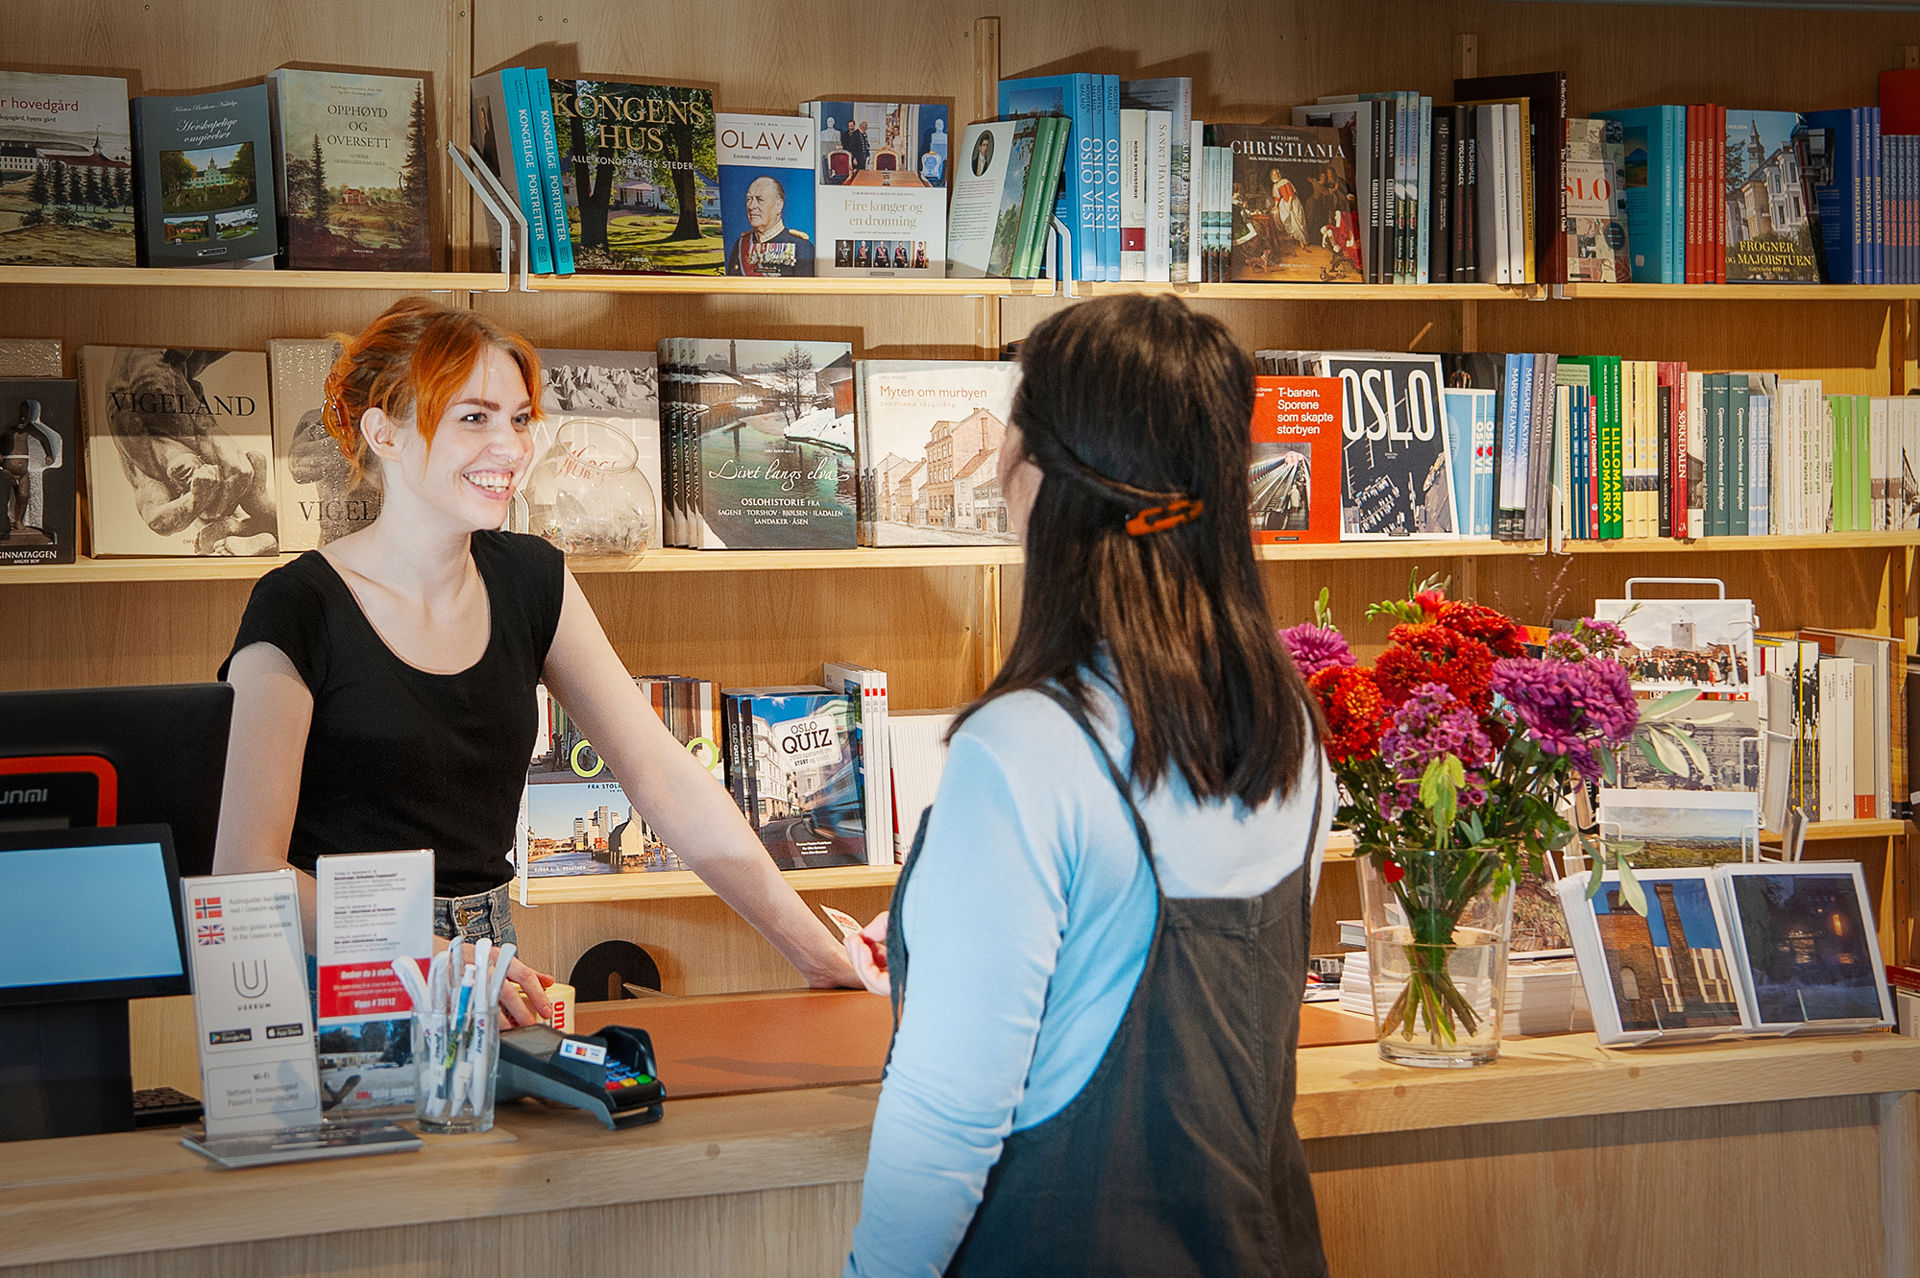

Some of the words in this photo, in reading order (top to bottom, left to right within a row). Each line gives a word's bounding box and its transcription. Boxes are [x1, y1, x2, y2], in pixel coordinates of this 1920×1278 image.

[11, 97, 79, 113] hovedgård
[327, 104, 388, 118] OPPHØYD
[553, 92, 706, 126] KONGENS
[348, 121, 368, 132] OG
[327, 135, 391, 148] OVERSETT
[599, 124, 664, 152] HUS
[1158, 124, 1167, 159] SANKT
[1181, 139, 1190, 159] SLIK
[1230, 140, 1345, 159] CHRISTIANIA
[571, 155, 590, 163] ALLE
[596, 157, 659, 168] KONGEPARETS
[662, 161, 694, 170] STEDER
[1081, 137, 1093, 184] OSLO
[1106, 139, 1119, 185] OSLO
[1181, 162, 1190, 179] BLE
[518, 109, 535, 168] KONGELIGE
[527, 174, 545, 240] PORTRETTER
[541, 110, 557, 169] KONGELIGE
[549, 175, 566, 242] PORTRETTER
[1385, 179, 1394, 209] CHRISTIAN
[1439, 184, 1449, 196] by
[844, 199, 868, 211] Fire
[870, 200, 908, 214] konger
[909, 203, 923, 214] og
[1081, 190, 1094, 232] VEST
[1106, 190, 1119, 233] VEST
[849, 216, 863, 226] en
[865, 215, 917, 229] dronning
[1386, 219, 1394, 227] BY
[1739, 240, 1795, 253] FROGNER
[1737, 253, 1812, 266] MAJORSTUEN
[880, 385, 914, 400] Myten
[917, 389, 935, 397] om
[939, 387, 987, 400] murbyen
[1277, 387, 1320, 397] T-banen.
[1536, 373, 1545, 415] KONGENS
[1546, 372, 1556, 415] KONGENS
[110, 391, 256, 417] VIGELAND
[1277, 399, 1319, 412] Sporene
[1338, 368, 1436, 442] OSLO
[1277, 414, 1298, 422] som
[1300, 412, 1333, 424] skapte
[1508, 368, 1519, 465] MARGARETAKYRKAN
[1521, 368, 1532, 465] MARGARETAKYRKAN
[1276, 424, 1320, 436] storbyen
[1678, 409, 1687, 478] SØRKEDALEN
[708, 459, 762, 480] Livet
[765, 458, 802, 492] langs
[807, 457, 851, 482] elva
[1602, 427, 1611, 523] LILLOMARKA
[1612, 427, 1621, 523] LILLOMARKA
[741, 498, 805, 506] OSLOHISTORIE
[792, 517, 809, 525] ÅSEN
[790, 721, 817, 734] OSLO
[782, 728, 833, 754] QUIZ
